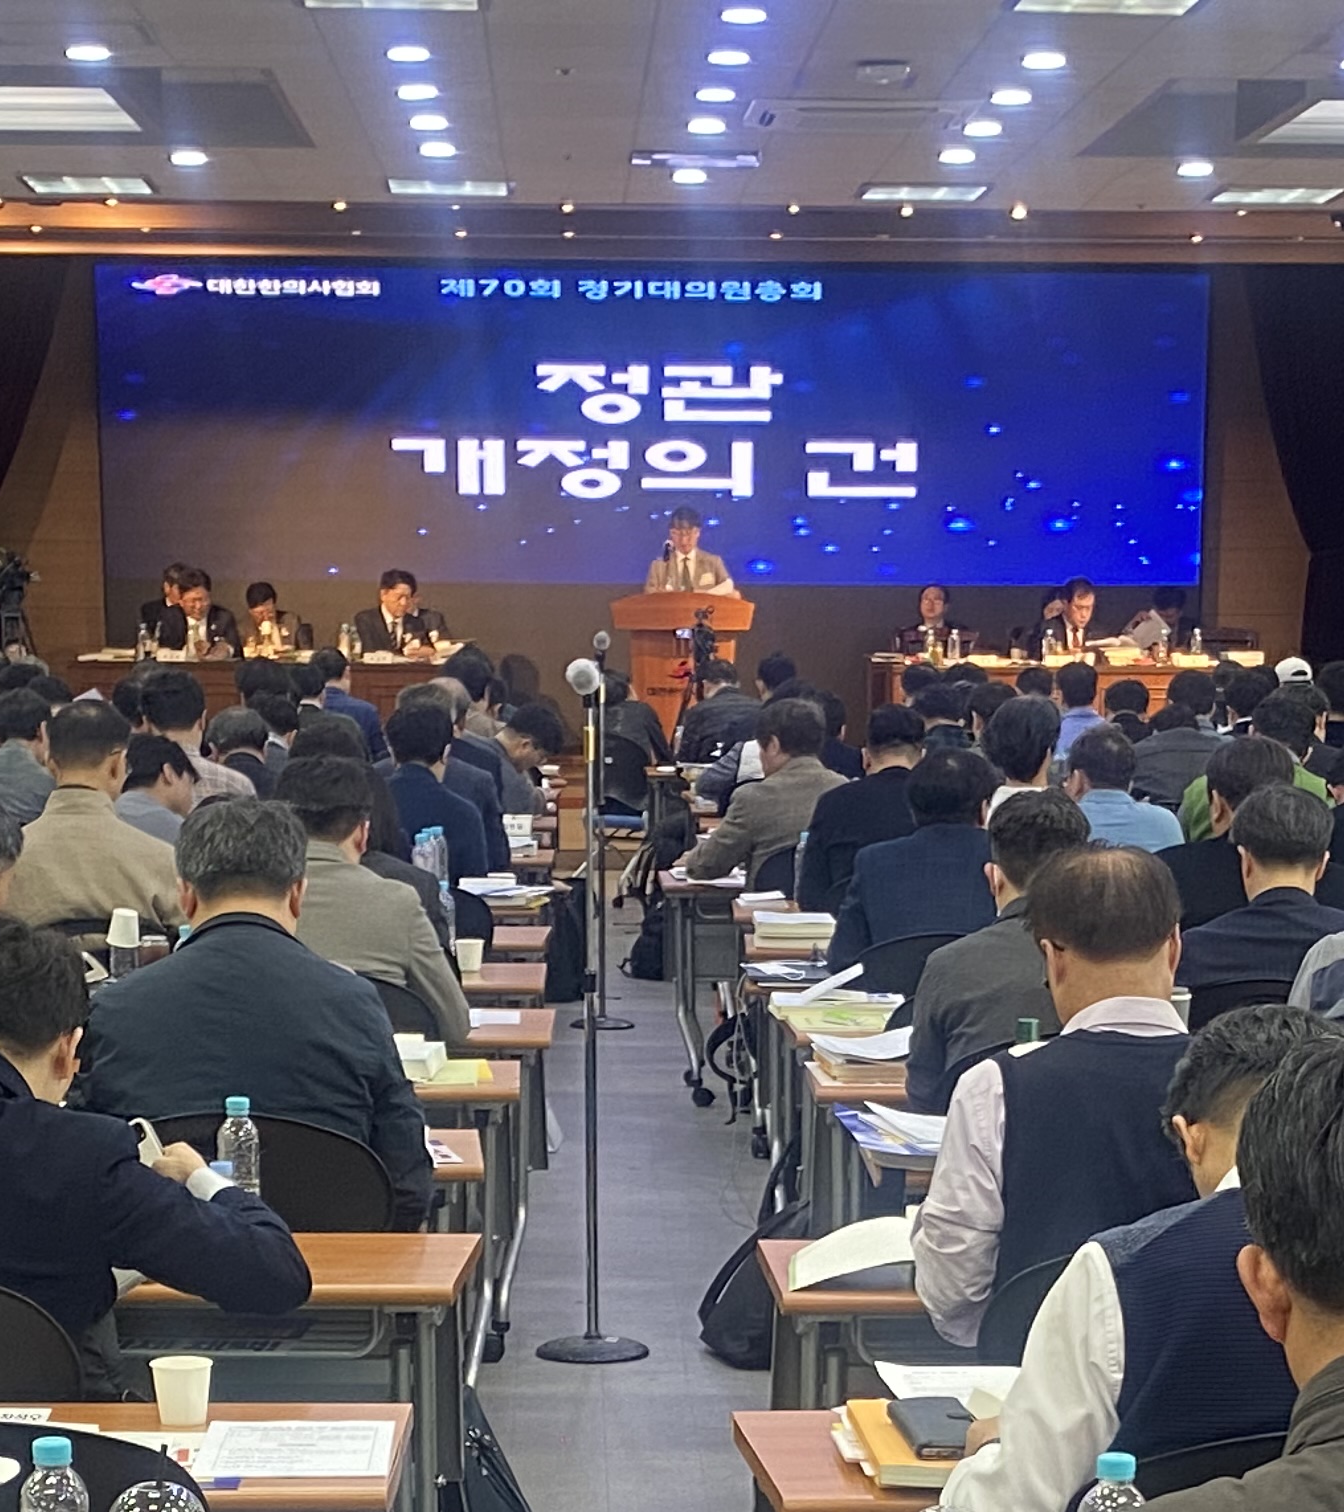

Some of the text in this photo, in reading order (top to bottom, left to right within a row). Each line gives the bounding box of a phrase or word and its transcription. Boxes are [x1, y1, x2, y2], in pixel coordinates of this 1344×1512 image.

[206, 277, 824, 302] 대한한의사협회 제70회 정기대의원총회
[535, 362, 784, 425] 정관
[391, 438, 919, 499] 개정의 건
